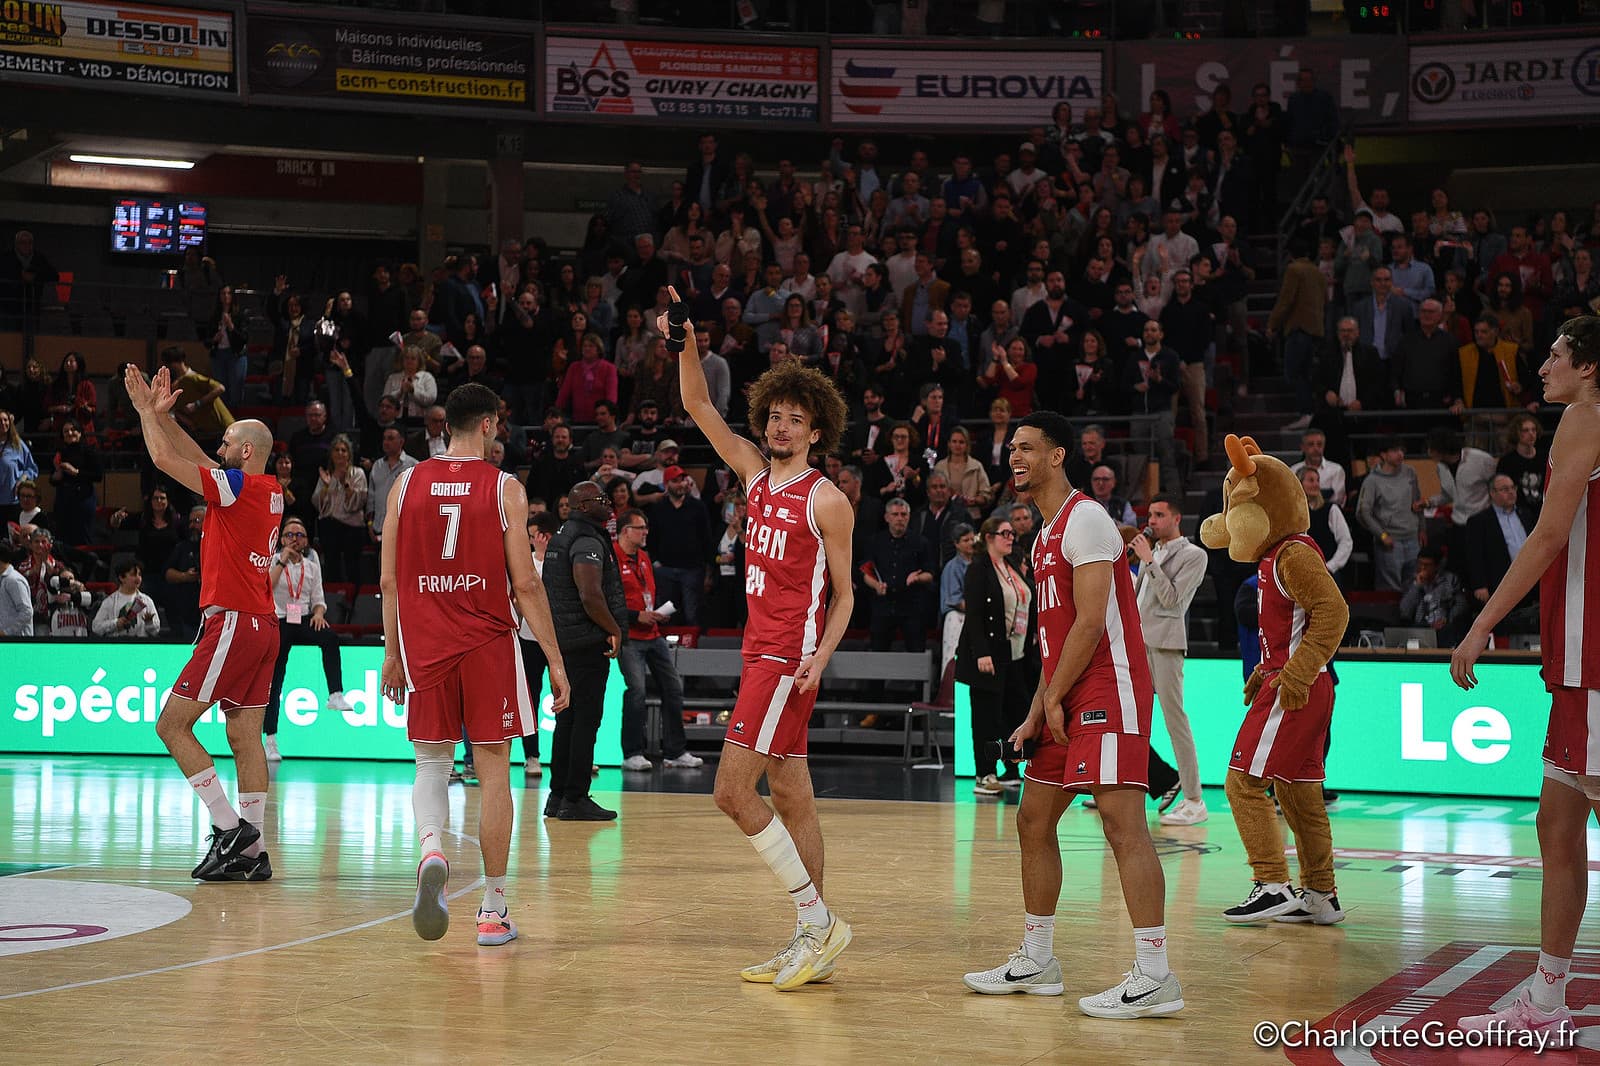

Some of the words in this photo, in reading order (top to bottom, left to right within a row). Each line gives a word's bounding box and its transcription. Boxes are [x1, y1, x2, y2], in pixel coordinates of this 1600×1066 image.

[0, 0, 61, 36] OLIN
[86, 17, 228, 48] DESSOLIN
[335, 29, 393, 47] Maisons
[397, 33, 483, 52] individuelles
[351, 48, 423, 67] Bâtiments
[426, 54, 526, 75] professionnels
[632, 47, 698, 59] CHAUFFAGE
[79, 62, 113, 78] VRD
[126, 64, 230, 89] DÉMOLITION
[659, 61, 723, 73] PLOMBERIE
[725, 63, 784, 75] SANITAIRE
[1462, 58, 1565, 85] JARDI
[340, 73, 523, 99] acm-construction.fr
[557, 67, 631, 97] BCS
[646, 79, 709, 95] GIVRY
[727, 82, 813, 99] CHAGNY
[916, 74, 1095, 99] EUROVIA
[658, 102, 675, 113] 03
[735, 104, 749, 115] 15
[760, 105, 813, 119] bcs71.fr
[439, 503, 461, 560] 7
[745, 564, 766, 597] 24
[252, 617, 259, 631] 4
[13, 666, 319, 737] spécie
[1400, 682, 1513, 765] Le
